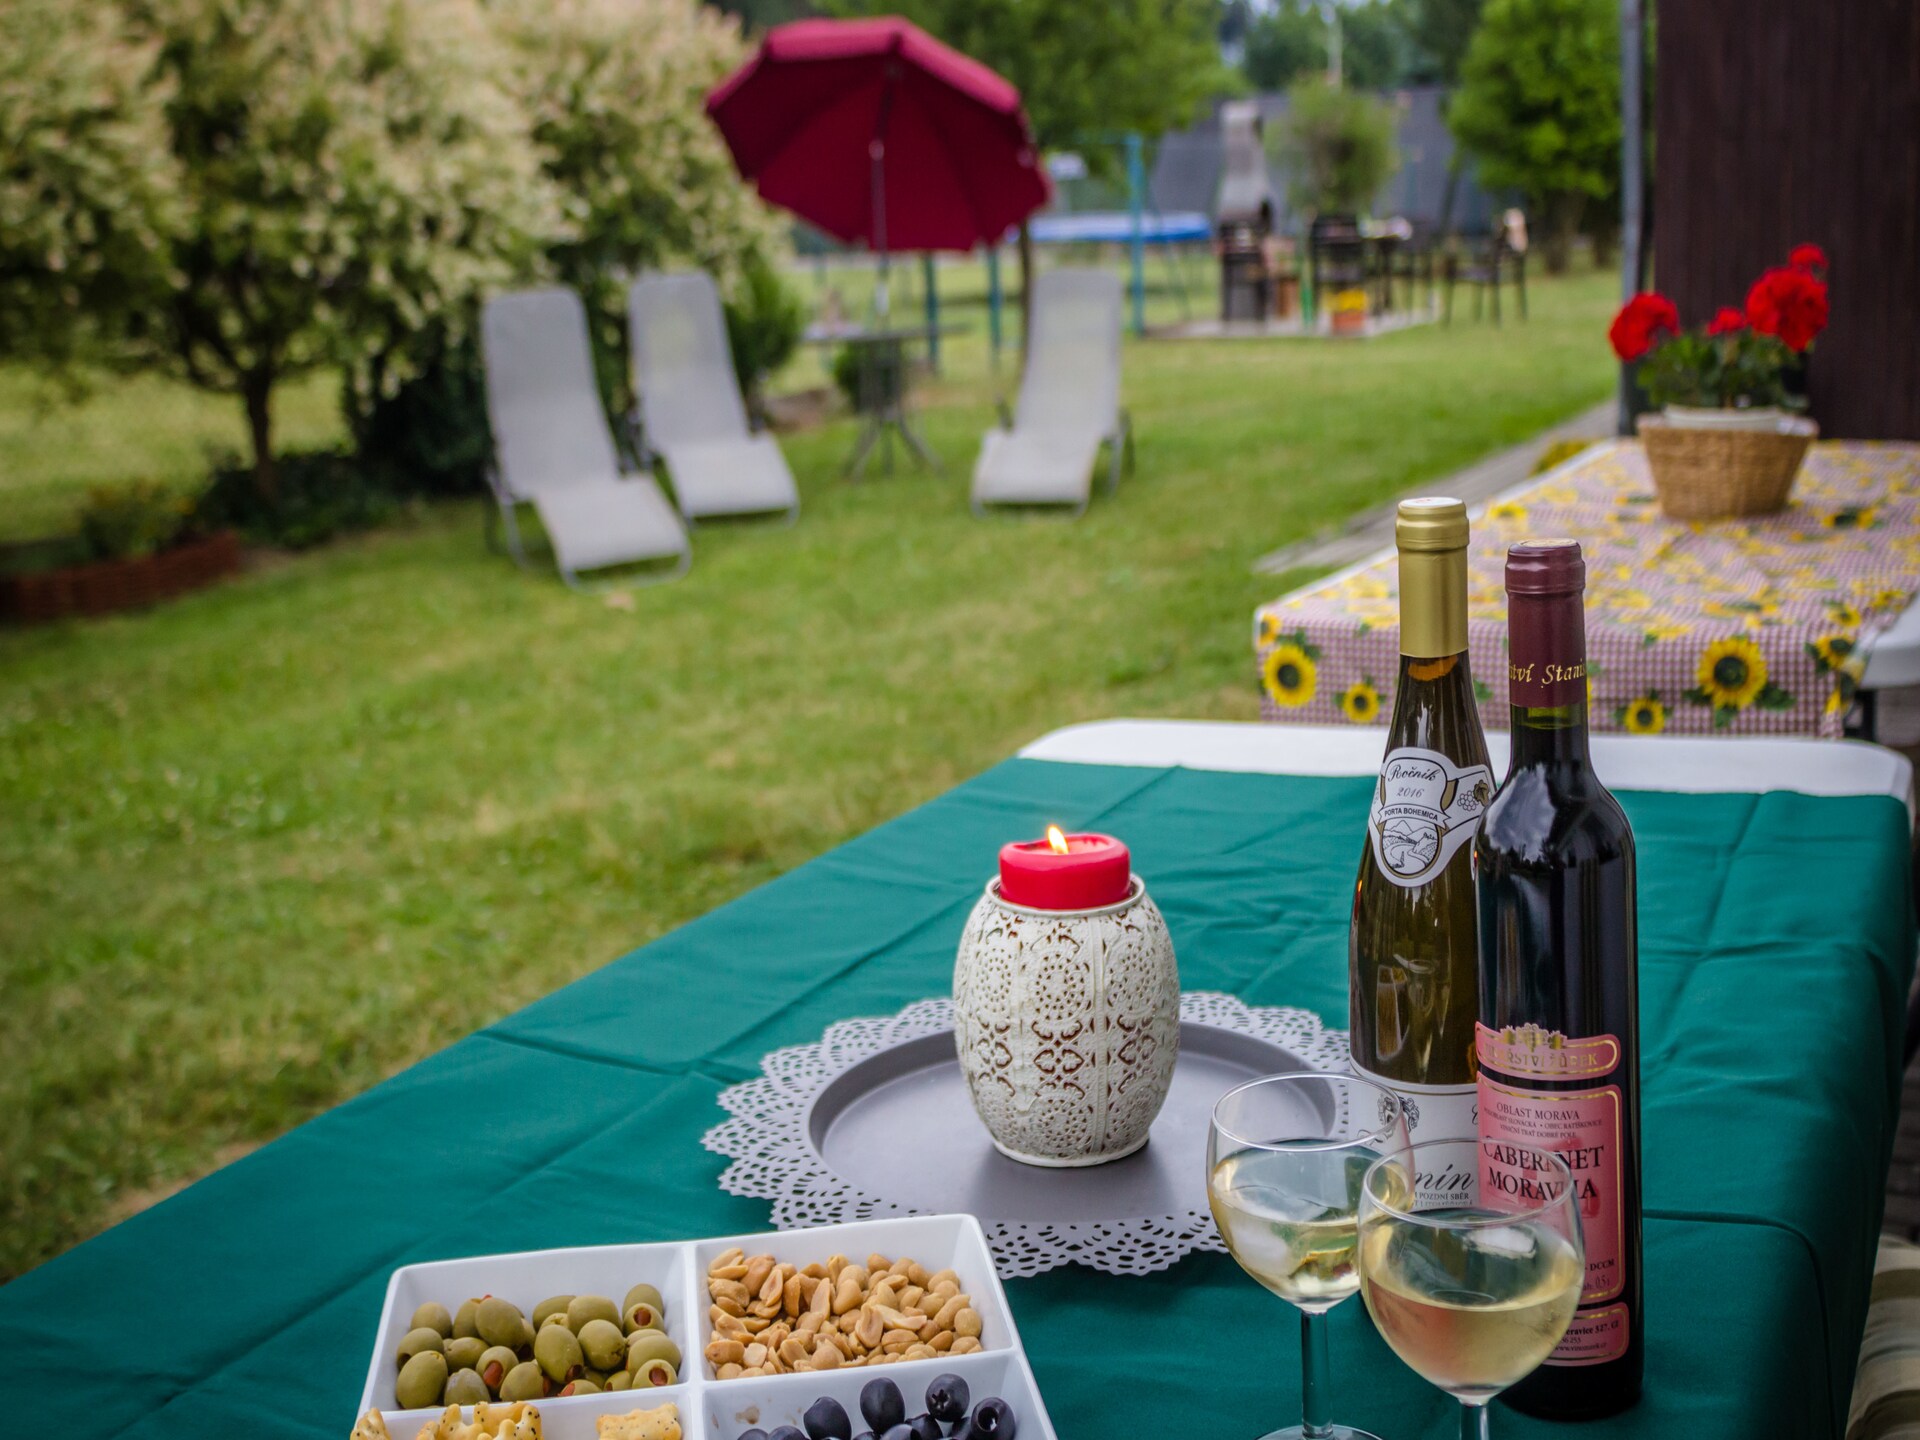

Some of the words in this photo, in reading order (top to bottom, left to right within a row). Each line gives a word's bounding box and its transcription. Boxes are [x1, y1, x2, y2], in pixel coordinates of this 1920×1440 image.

[1388, 764, 1440, 782] Ročník
[1397, 787, 1425, 798] 2016
[1384, 807, 1403, 817] PORTA
[1403, 807, 1439, 821] BOHEMICA
[1496, 1102, 1532, 1118] OBLAST
[1535, 1109, 1580, 1121] MORAVA
[1484, 1135, 1604, 1173] CABERNET
[1450, 1191, 1470, 1200] SBĚR
[1566, 1326, 1594, 1336] eravice
